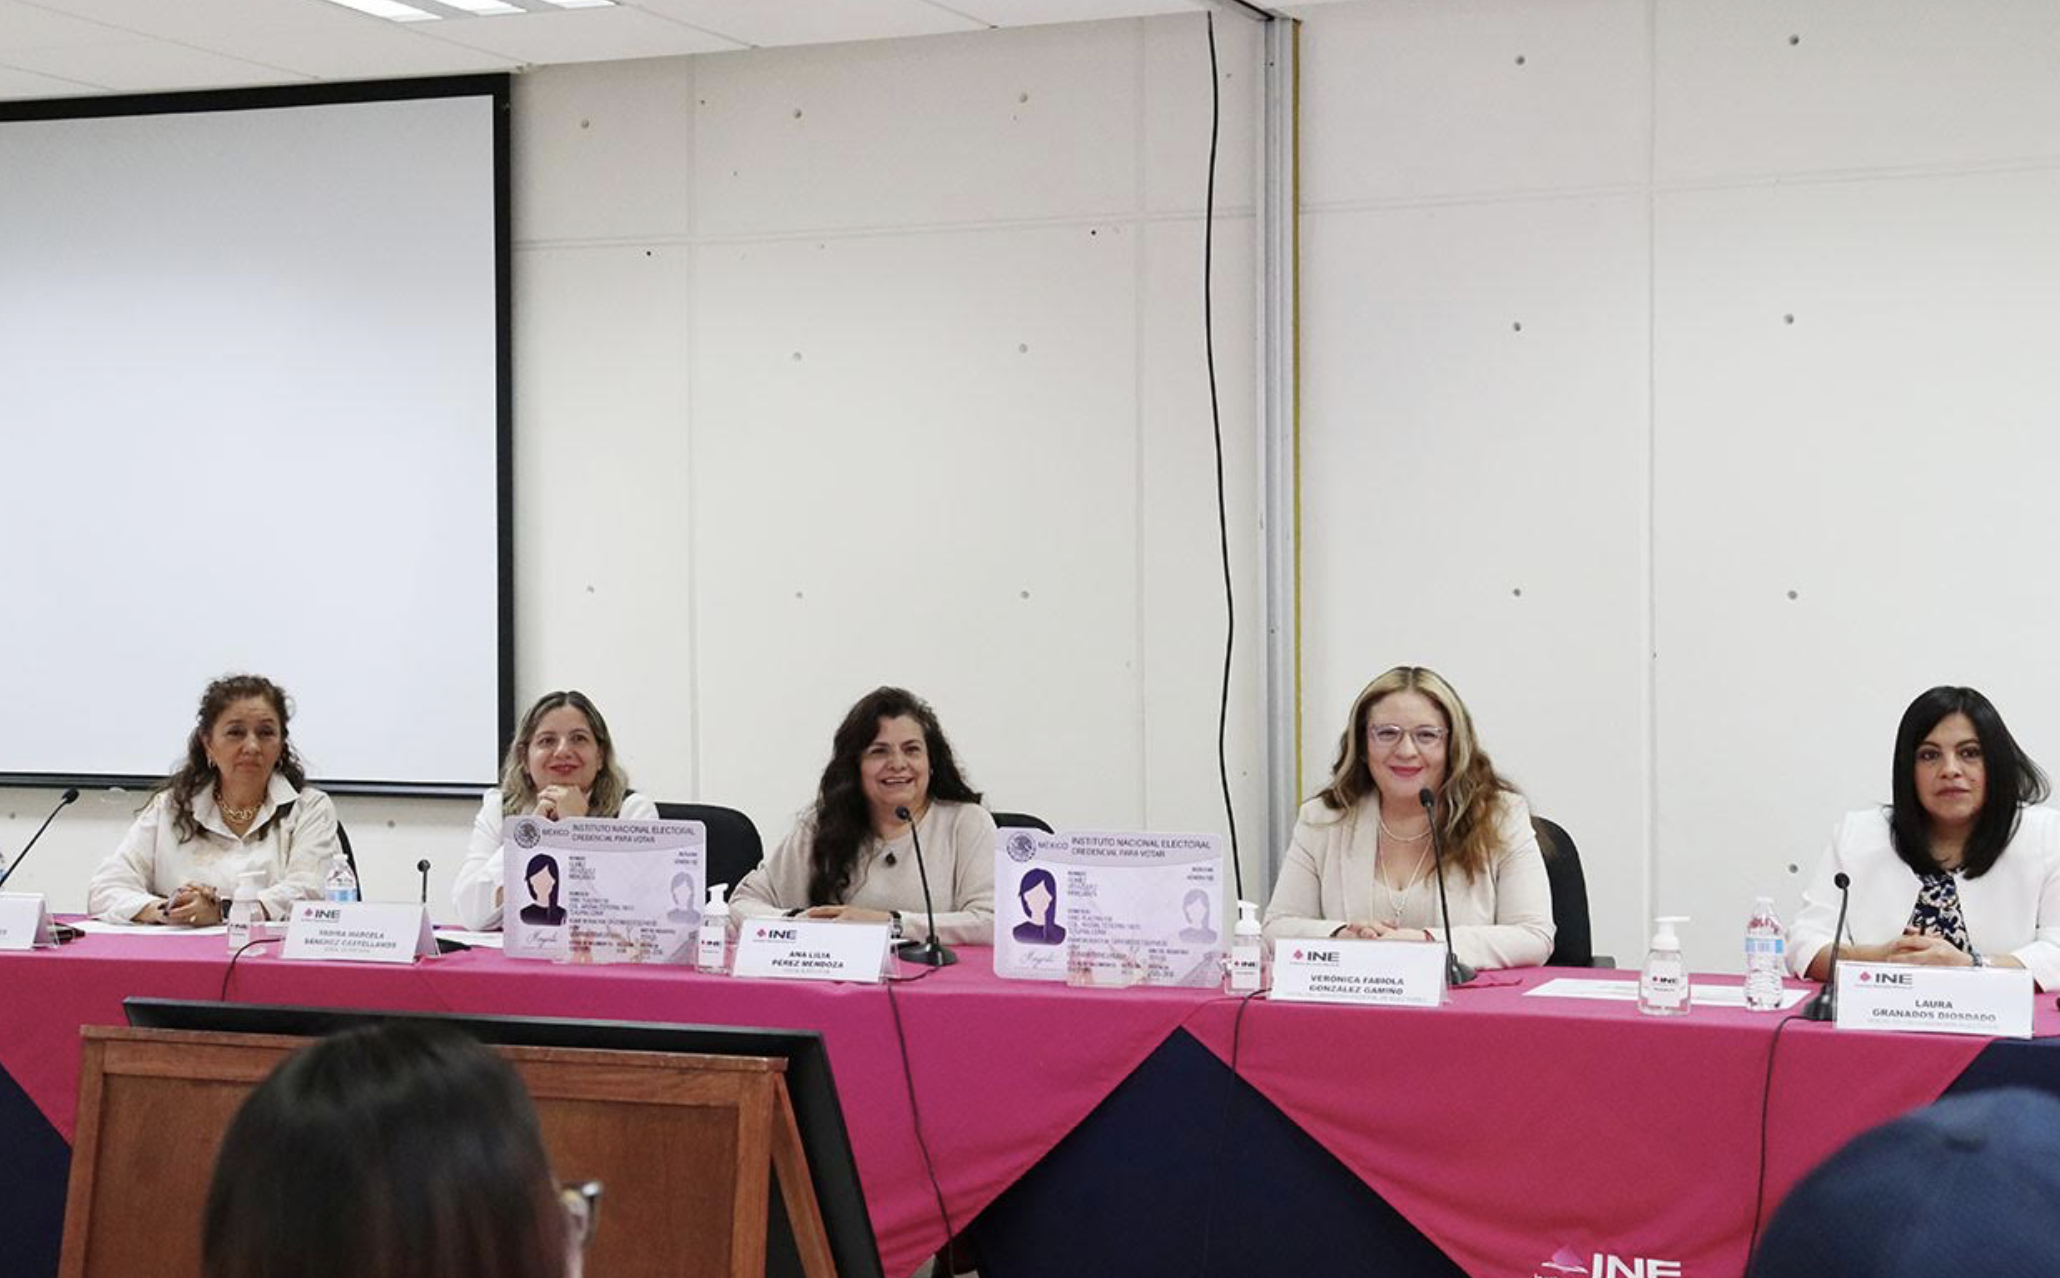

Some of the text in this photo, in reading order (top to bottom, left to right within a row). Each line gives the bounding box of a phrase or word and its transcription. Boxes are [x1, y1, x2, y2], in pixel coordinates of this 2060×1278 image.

[572, 824, 696, 836] INSTITUTO NACIONAL ELECTORAL
[572, 833, 657, 844] CREDENCIAL PARA VOTAR
[1071, 837, 1211, 850] INSTITUTO NACIONAL ELECTORAL
[1071, 847, 1165, 858] CREDENCIAL PARA VOTAR
[315, 909, 341, 919] INE
[348, 930, 385, 939] MARCELA
[768, 929, 797, 939] INE
[341, 939, 397, 949] CASTELLANOS
[789, 950, 807, 958] ANA
[1307, 951, 1340, 962] INE
[802, 960, 844, 969] MENDOZA
[1363, 976, 1405, 986] FABIOLA
[1875, 972, 1913, 985] INE
[1914, 999, 1954, 1010] LAURA
[1872, 1008, 1996, 1022] GRANADOS DIOSDADO
